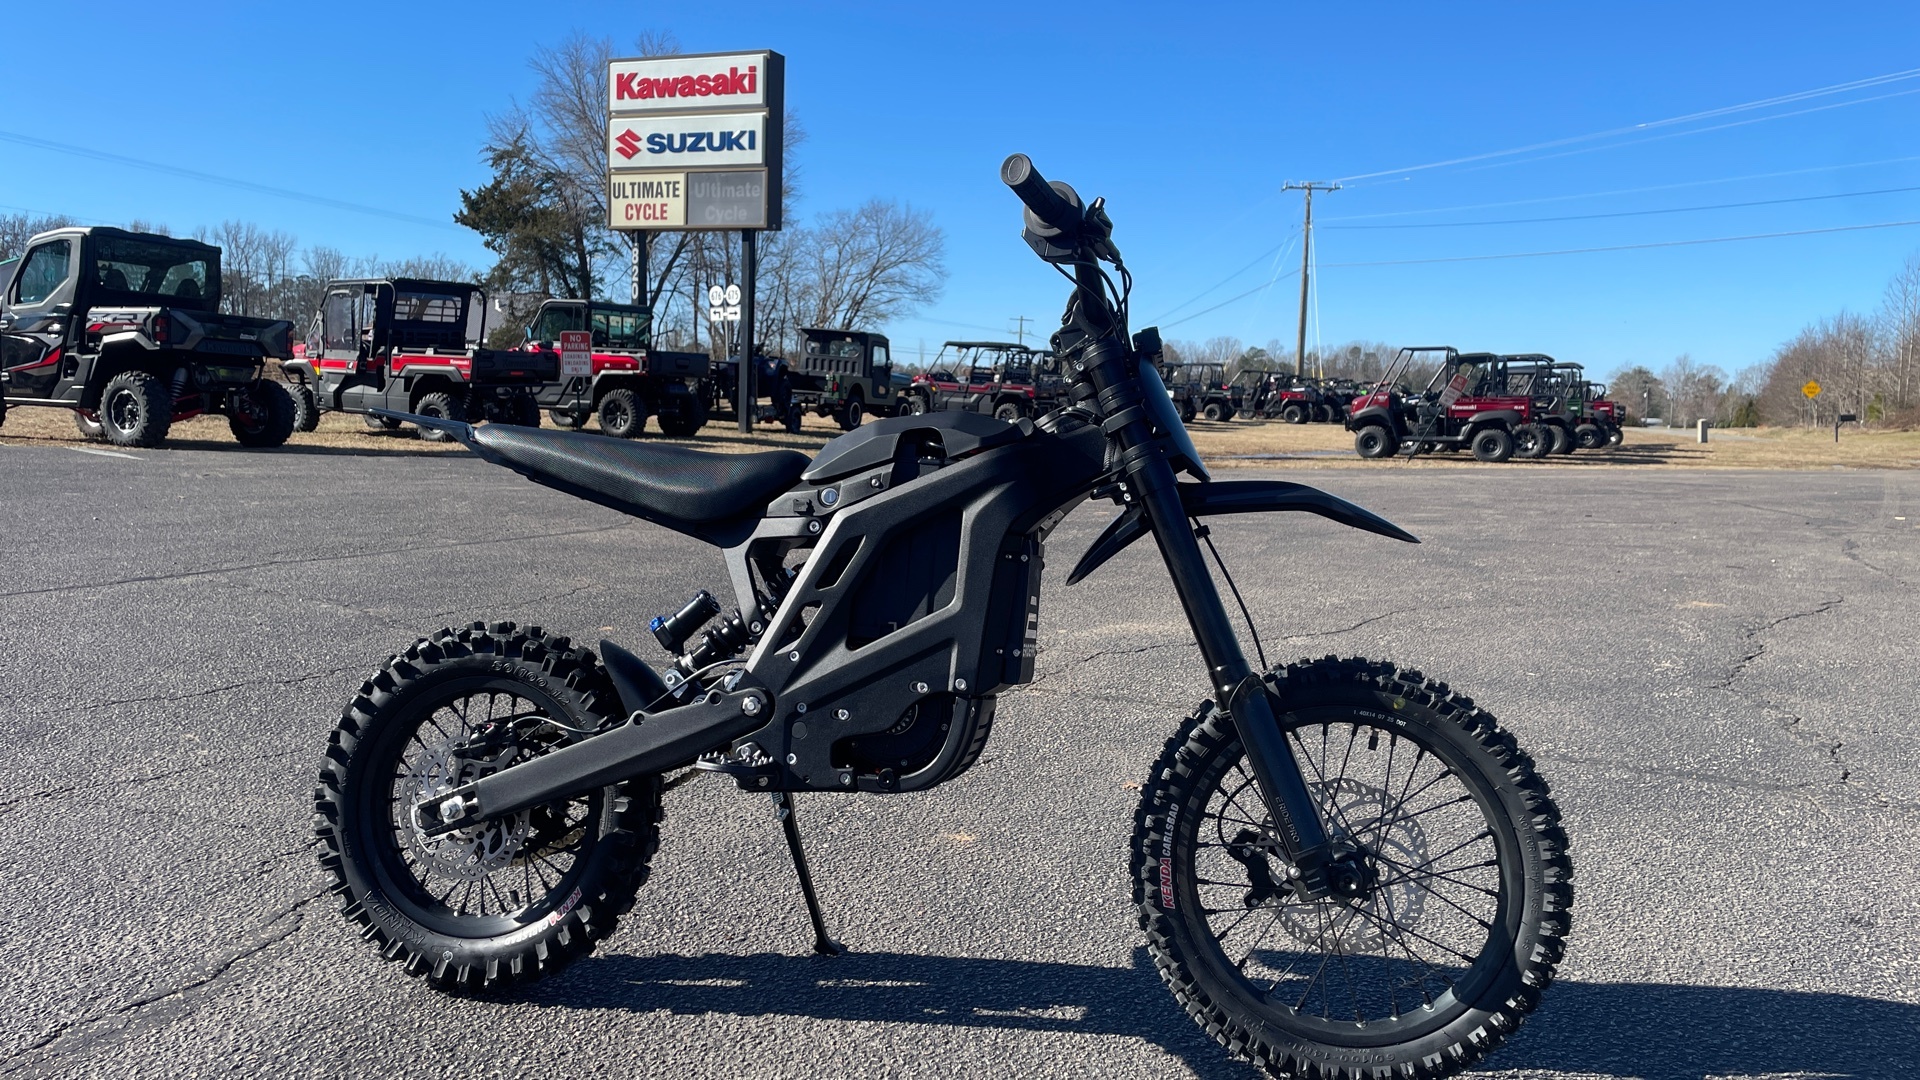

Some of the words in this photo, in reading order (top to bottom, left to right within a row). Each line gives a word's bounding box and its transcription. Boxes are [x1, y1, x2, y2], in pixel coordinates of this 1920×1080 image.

[616, 65, 757, 100] Kawasaki
[646, 130, 756, 154] SUZUKI
[612, 181, 681, 199] ULTIMATE
[694, 182, 761, 197] Ultimate
[625, 203, 668, 221] CYCLE
[705, 205, 748, 224] Cycle
[563, 342, 589, 350] PARKING
[569, 334, 582, 342] NO
[1396, 718, 1407, 727] DOT
[1162, 802, 1180, 857] CARLSBAD
[1517, 814, 1532, 832] NOT
[1524, 834, 1537, 853] FOR
[1160, 857, 1175, 909] KENDA
[549, 885, 583, 927] KENDA
[1530, 897, 1540, 916] USE
[363, 890, 426, 946] KENDA
